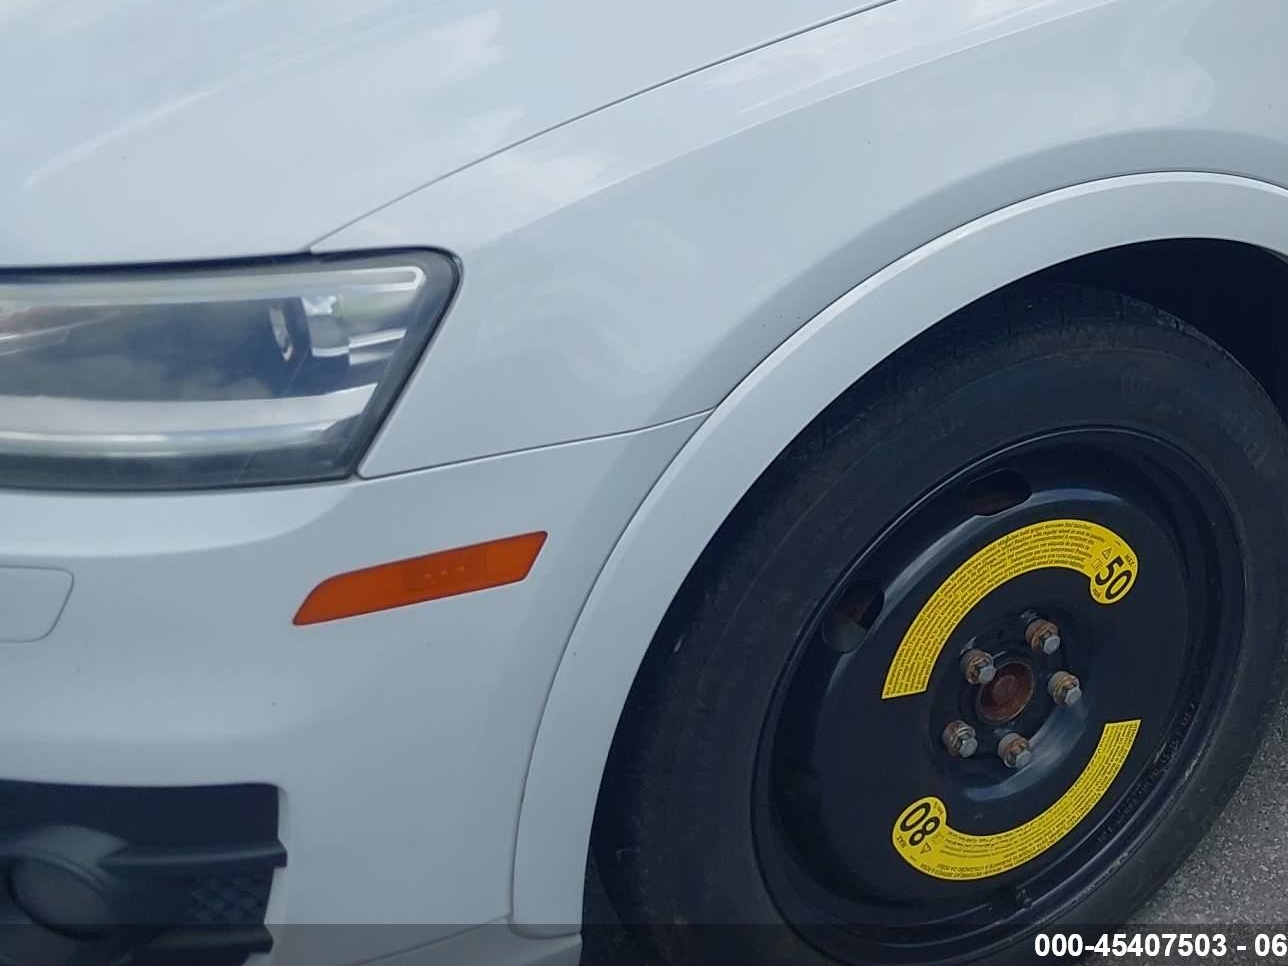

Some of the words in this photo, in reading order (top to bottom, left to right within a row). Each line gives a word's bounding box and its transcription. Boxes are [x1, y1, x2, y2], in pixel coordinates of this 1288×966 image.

[1125, 553, 1135, 566] MAX
[1095, 555, 1132, 600] 50
[899, 802, 940, 846] 80
[896, 835, 906, 848] MAX
